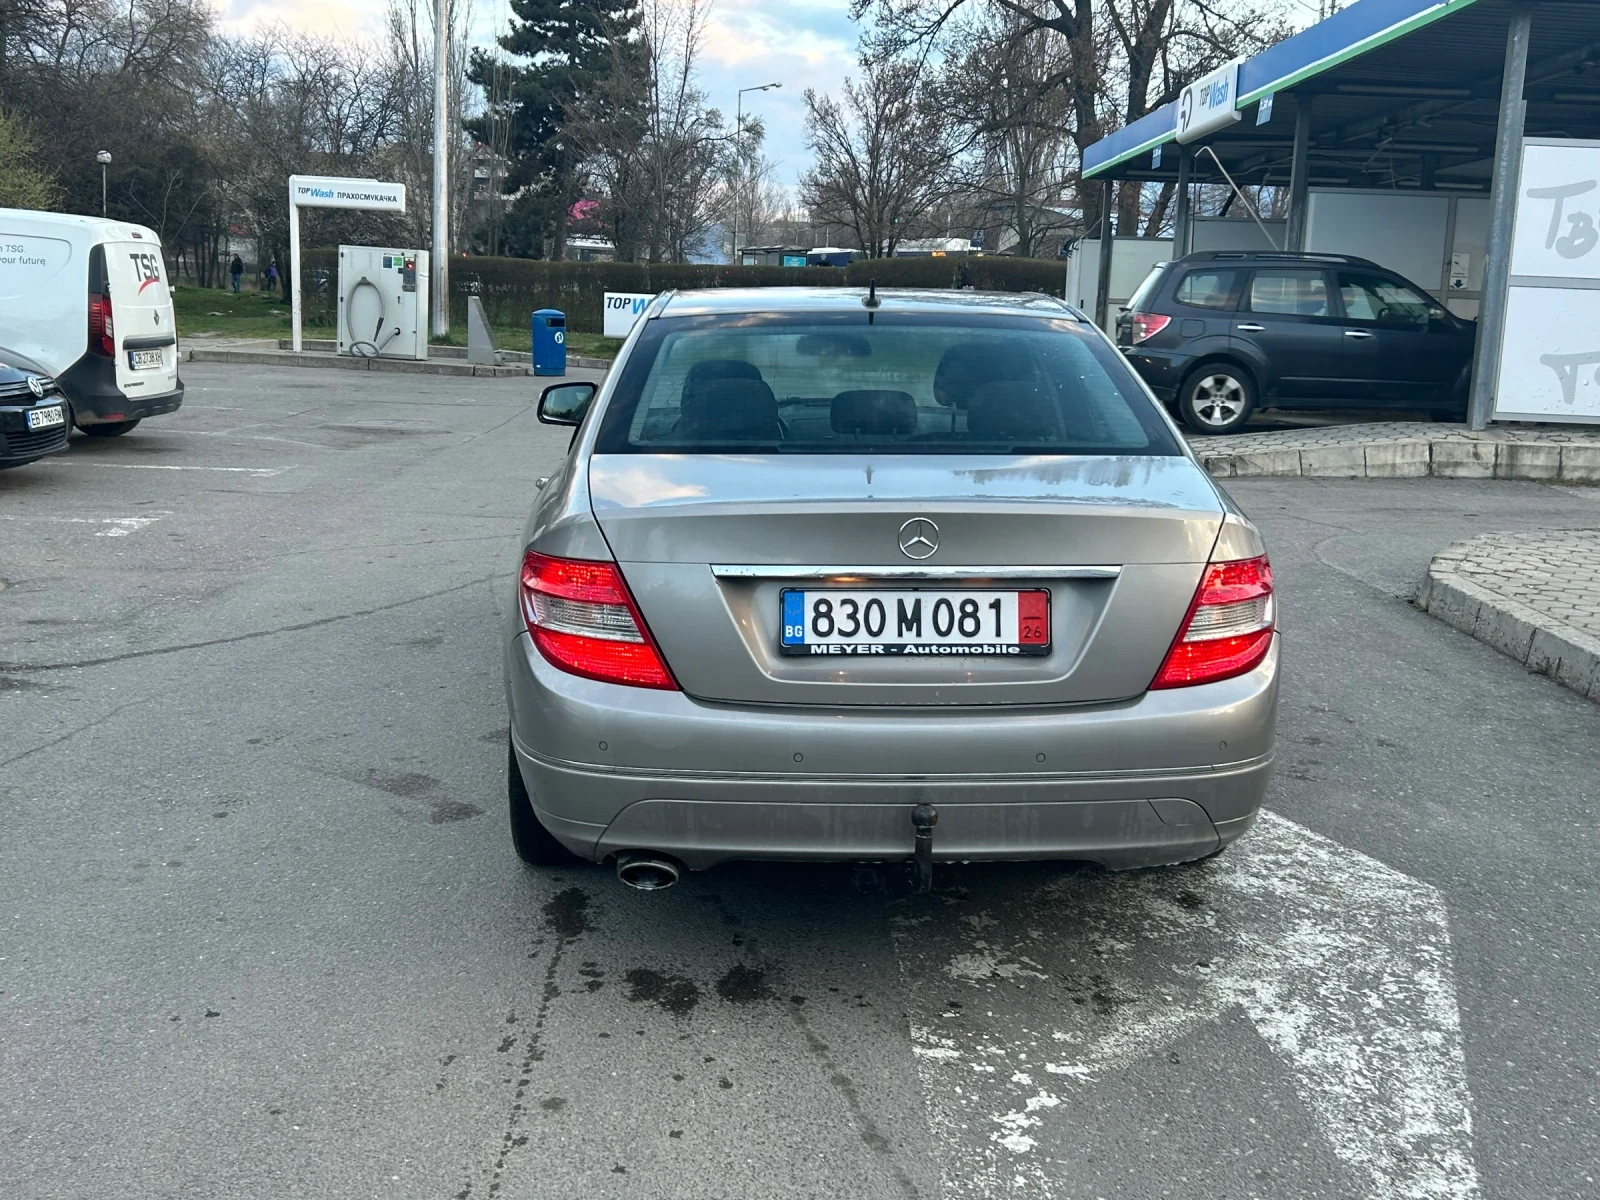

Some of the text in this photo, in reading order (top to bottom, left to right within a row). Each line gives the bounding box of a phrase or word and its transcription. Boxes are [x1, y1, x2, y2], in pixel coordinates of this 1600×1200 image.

[337, 191, 398, 203] ПРАХОСМУКАЧКА
[129, 253, 160, 282] TSG
[811, 598, 1001, 638] 830 M 081
[785, 625, 803, 638] BG
[1023, 625, 1042, 639] 26
[810, 644, 885, 654] MEYER
[903, 644, 1021, 655] Automobile
